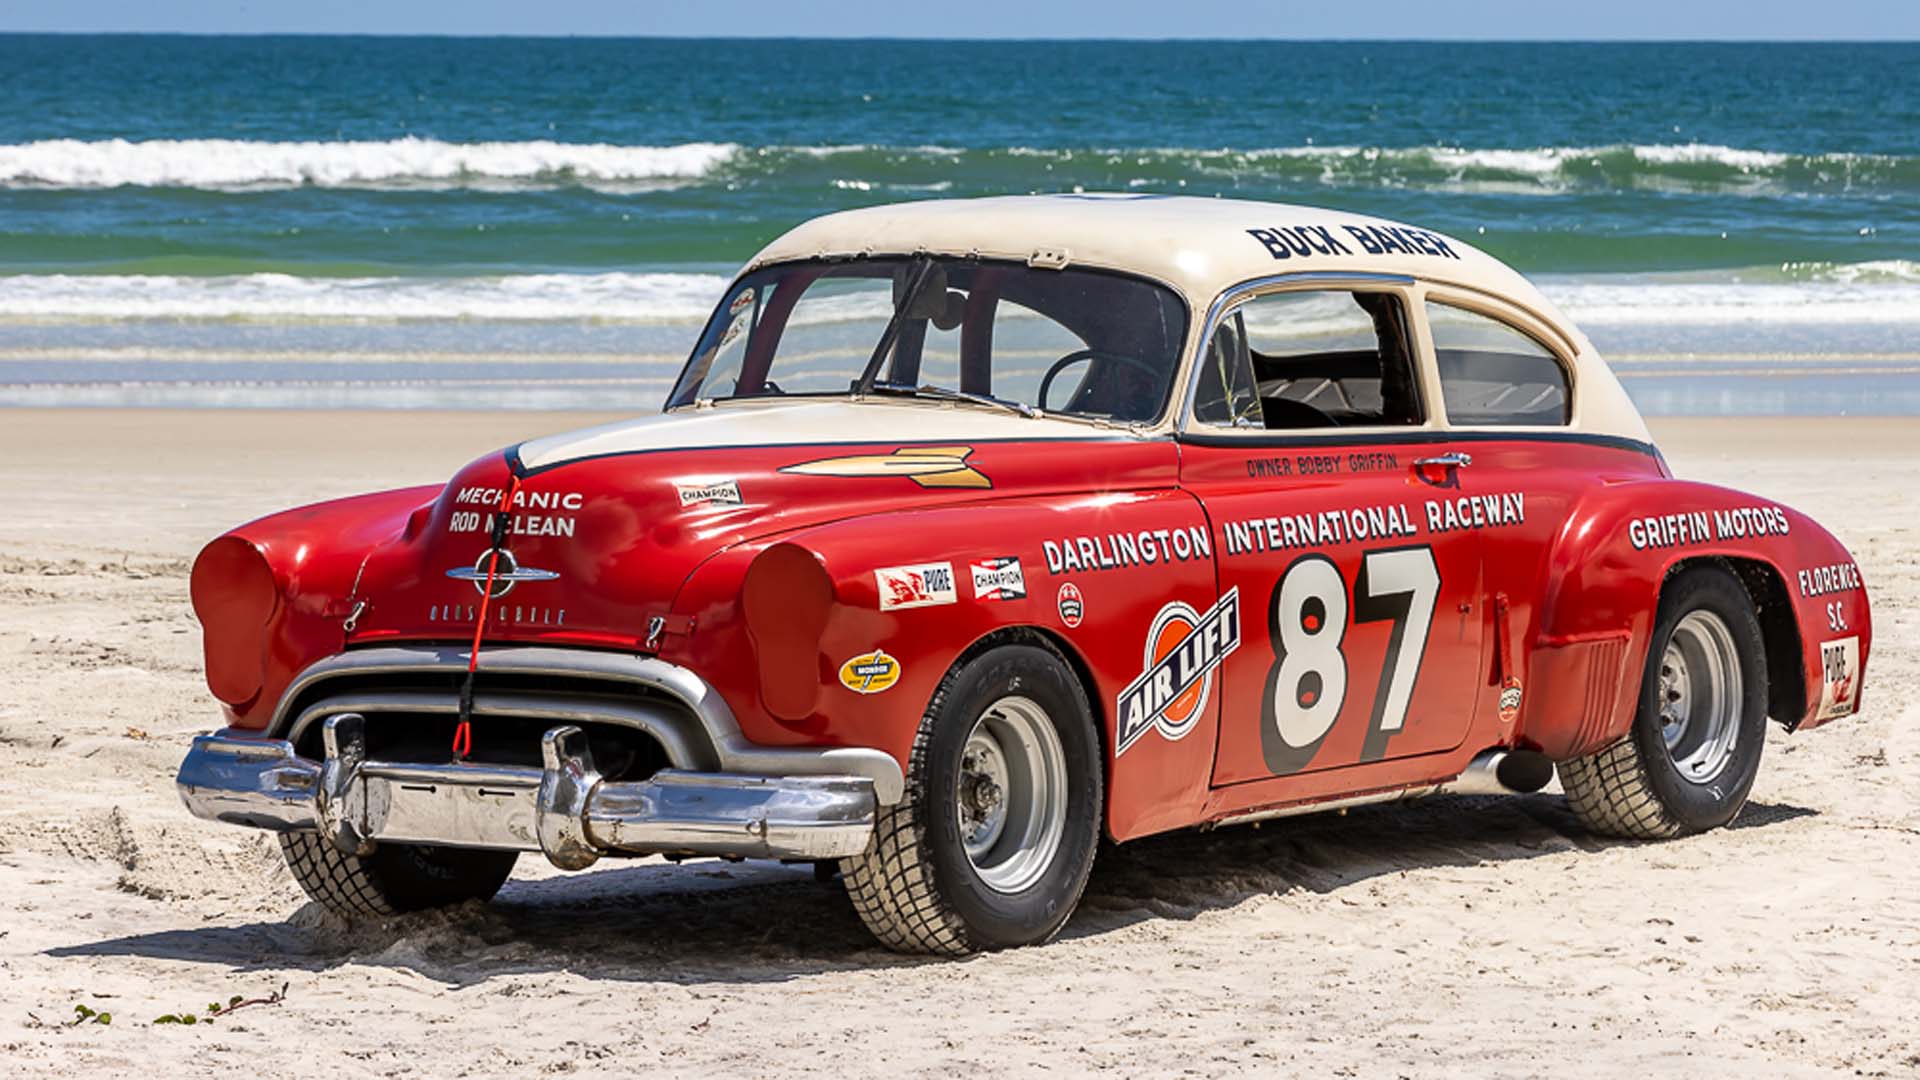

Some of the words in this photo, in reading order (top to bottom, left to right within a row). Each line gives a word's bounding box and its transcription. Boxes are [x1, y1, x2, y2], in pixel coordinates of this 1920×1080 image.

[1246, 225, 1354, 259] BUCK
[1340, 224, 1462, 260] BAKER
[1247, 457, 1293, 478] OWNER
[1297, 455, 1343, 475] BOBBY
[1348, 452, 1399, 472] GRIFFIN
[681, 487, 738, 502] CHAMPION
[449, 510, 481, 533] ROD
[1043, 526, 1212, 575] DARLINGTON
[1223, 503, 1418, 555] INTERNATIONAL
[1424, 491, 1526, 534] RACEWAY
[1629, 511, 1712, 551] GRIFFIN
[1713, 506, 1791, 541] MOTORS
[923, 567, 952, 594] PURE
[974, 571, 1024, 588] CHAMPION
[1798, 562, 1862, 598] FLORENCE
[429, 604, 566, 626] OLDSOBILE
[1826, 600, 1849, 632] S.C.
[1266, 545, 1442, 757] 87
[1823, 644, 1847, 684] PURE
[1125, 664, 1175, 738] AIR
[1180, 603, 1235, 687] LIFT
